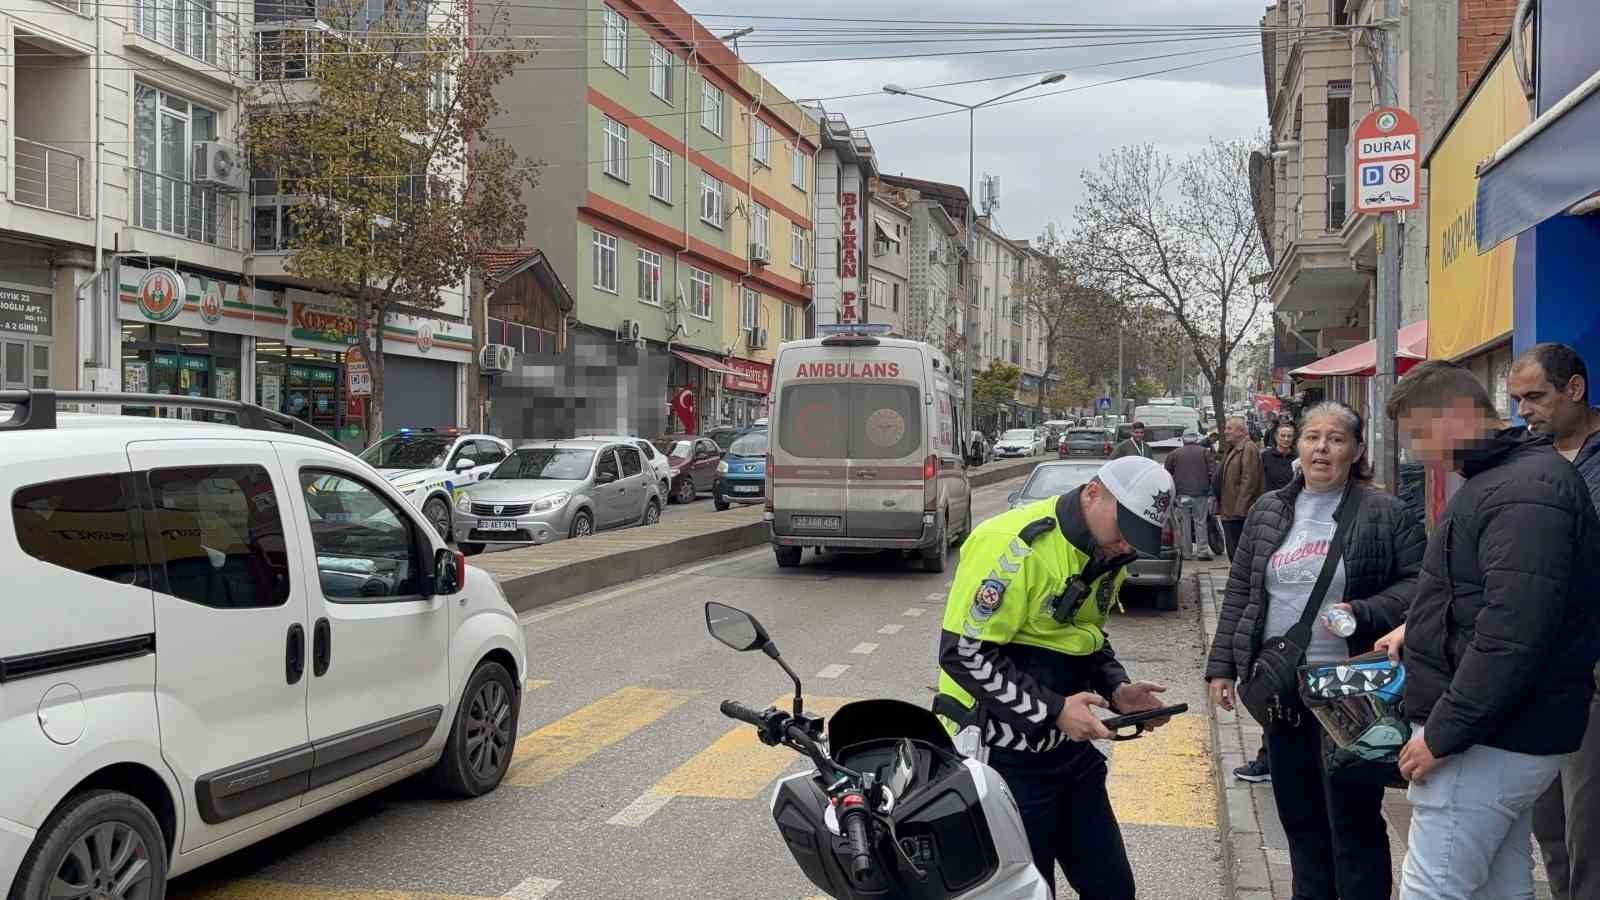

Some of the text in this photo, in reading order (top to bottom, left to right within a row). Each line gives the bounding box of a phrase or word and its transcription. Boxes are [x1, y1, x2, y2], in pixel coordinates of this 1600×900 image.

[1363, 139, 1411, 154] DURAK
[1366, 168, 1380, 185] D
[842, 192, 857, 323] BALKAN PA
[796, 361, 900, 378] AMBULANS
